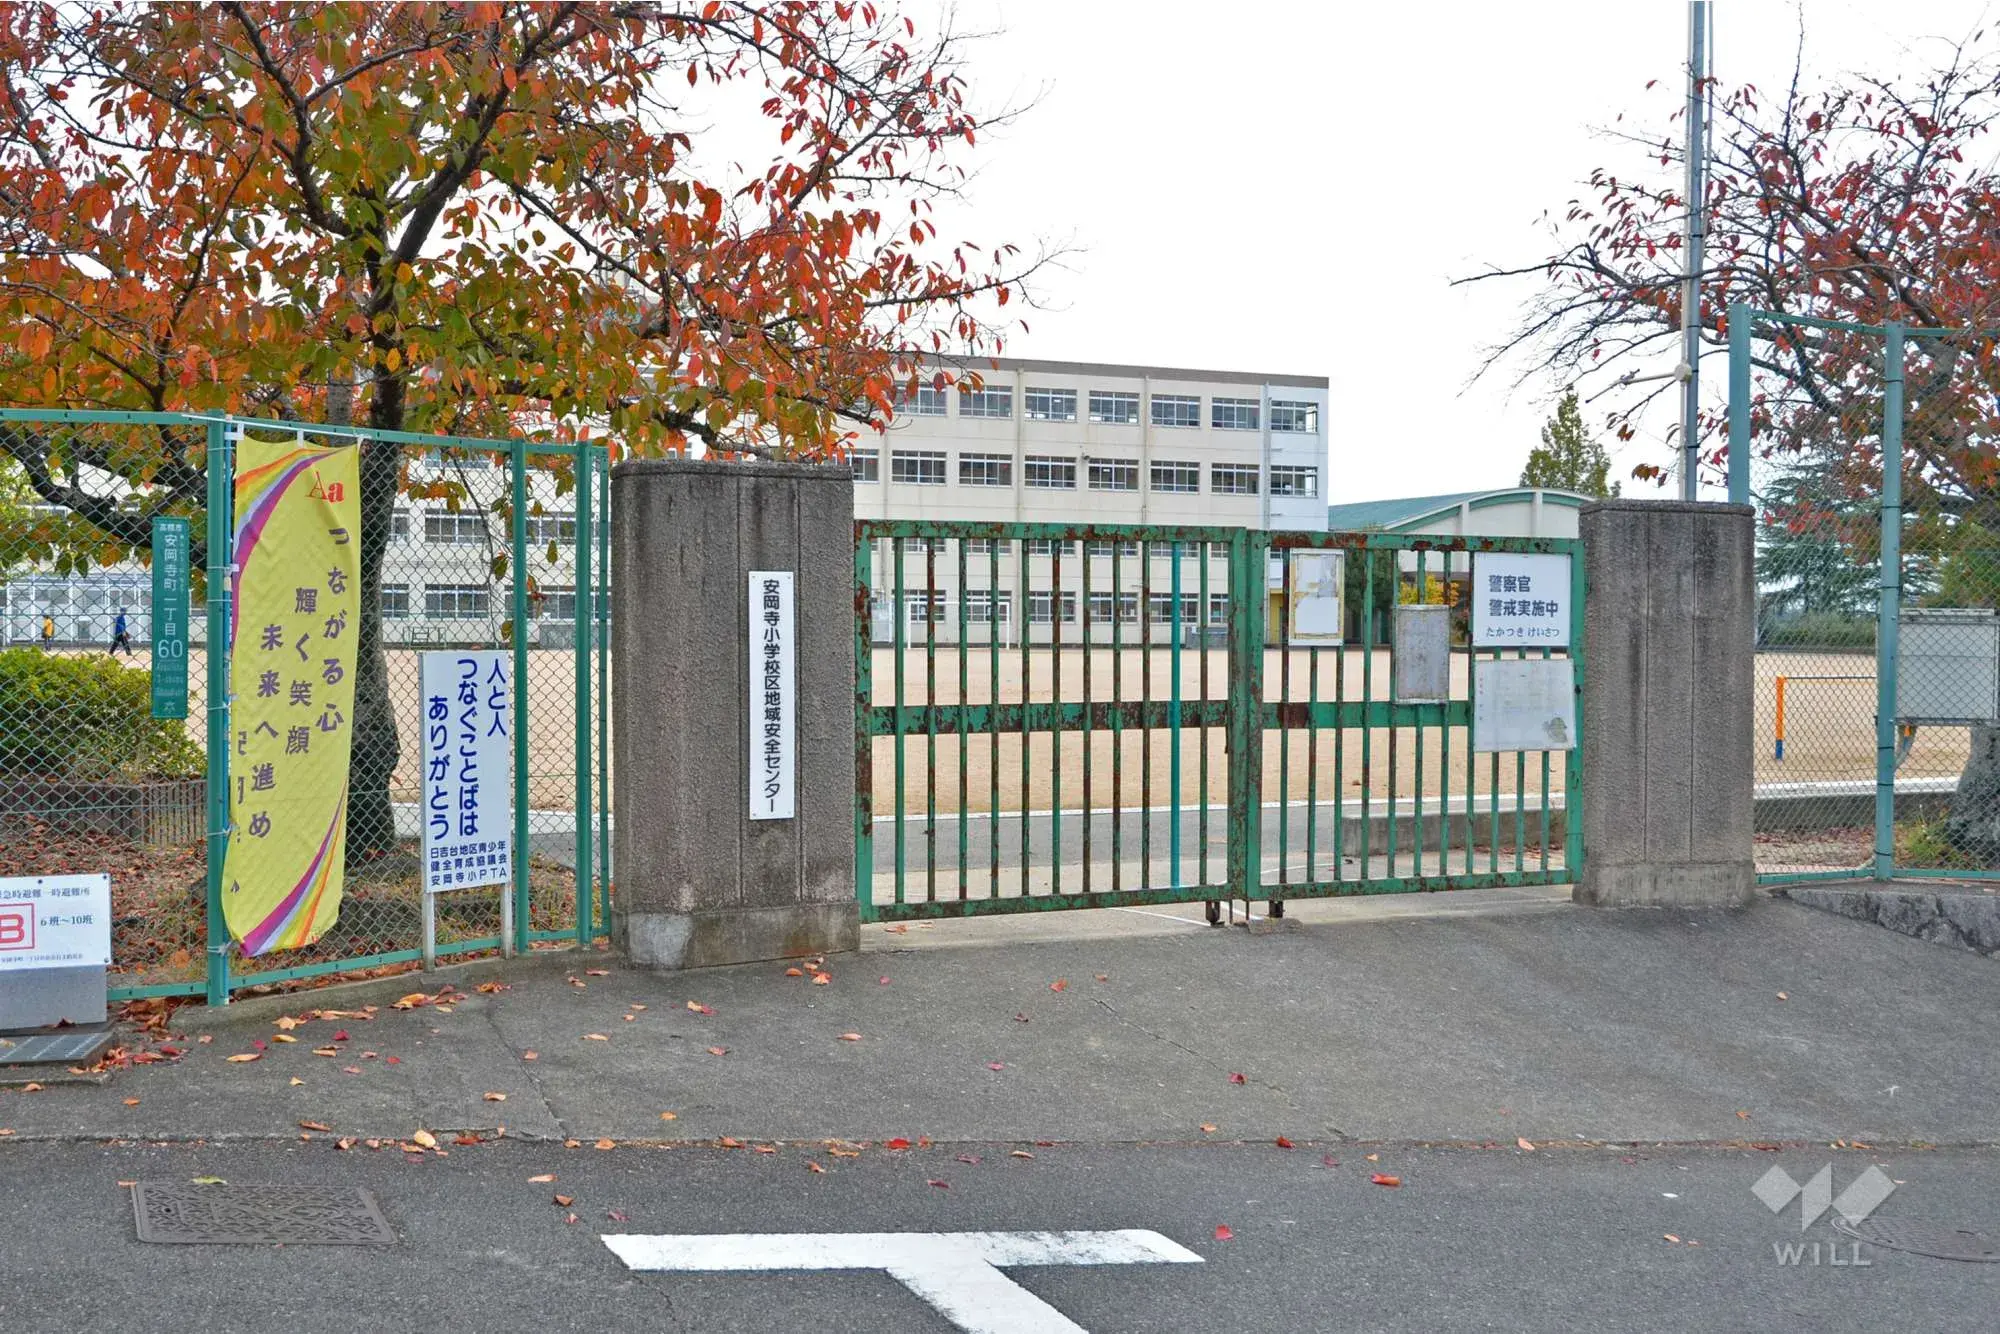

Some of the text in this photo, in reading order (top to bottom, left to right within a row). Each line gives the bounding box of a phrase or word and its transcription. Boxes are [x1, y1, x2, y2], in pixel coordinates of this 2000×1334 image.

[305, 471, 345, 502] Aa
[164, 534, 177, 636] 安岡寺町一丁目
[1489, 575, 1531, 592] 警察官
[1489, 599, 1559, 617] 警戒実施中
[158, 639, 183, 658] 60
[315, 528, 350, 732] つながる心
[1486, 627, 1560, 637] たかつき けいさつ
[285, 587, 318, 754] 輝く笑顔
[487, 658, 507, 737] 人と人
[763, 579, 781, 813] 安岡寺小学校区地域安全センター
[248, 624, 284, 838] 未来へ進め
[428, 695, 450, 841] ありがとう
[457, 658, 479, 837] つなぐことばは
[430, 840, 506, 859] 日吉台地区青少年
[0, 889, 42, 899] 急時避難
